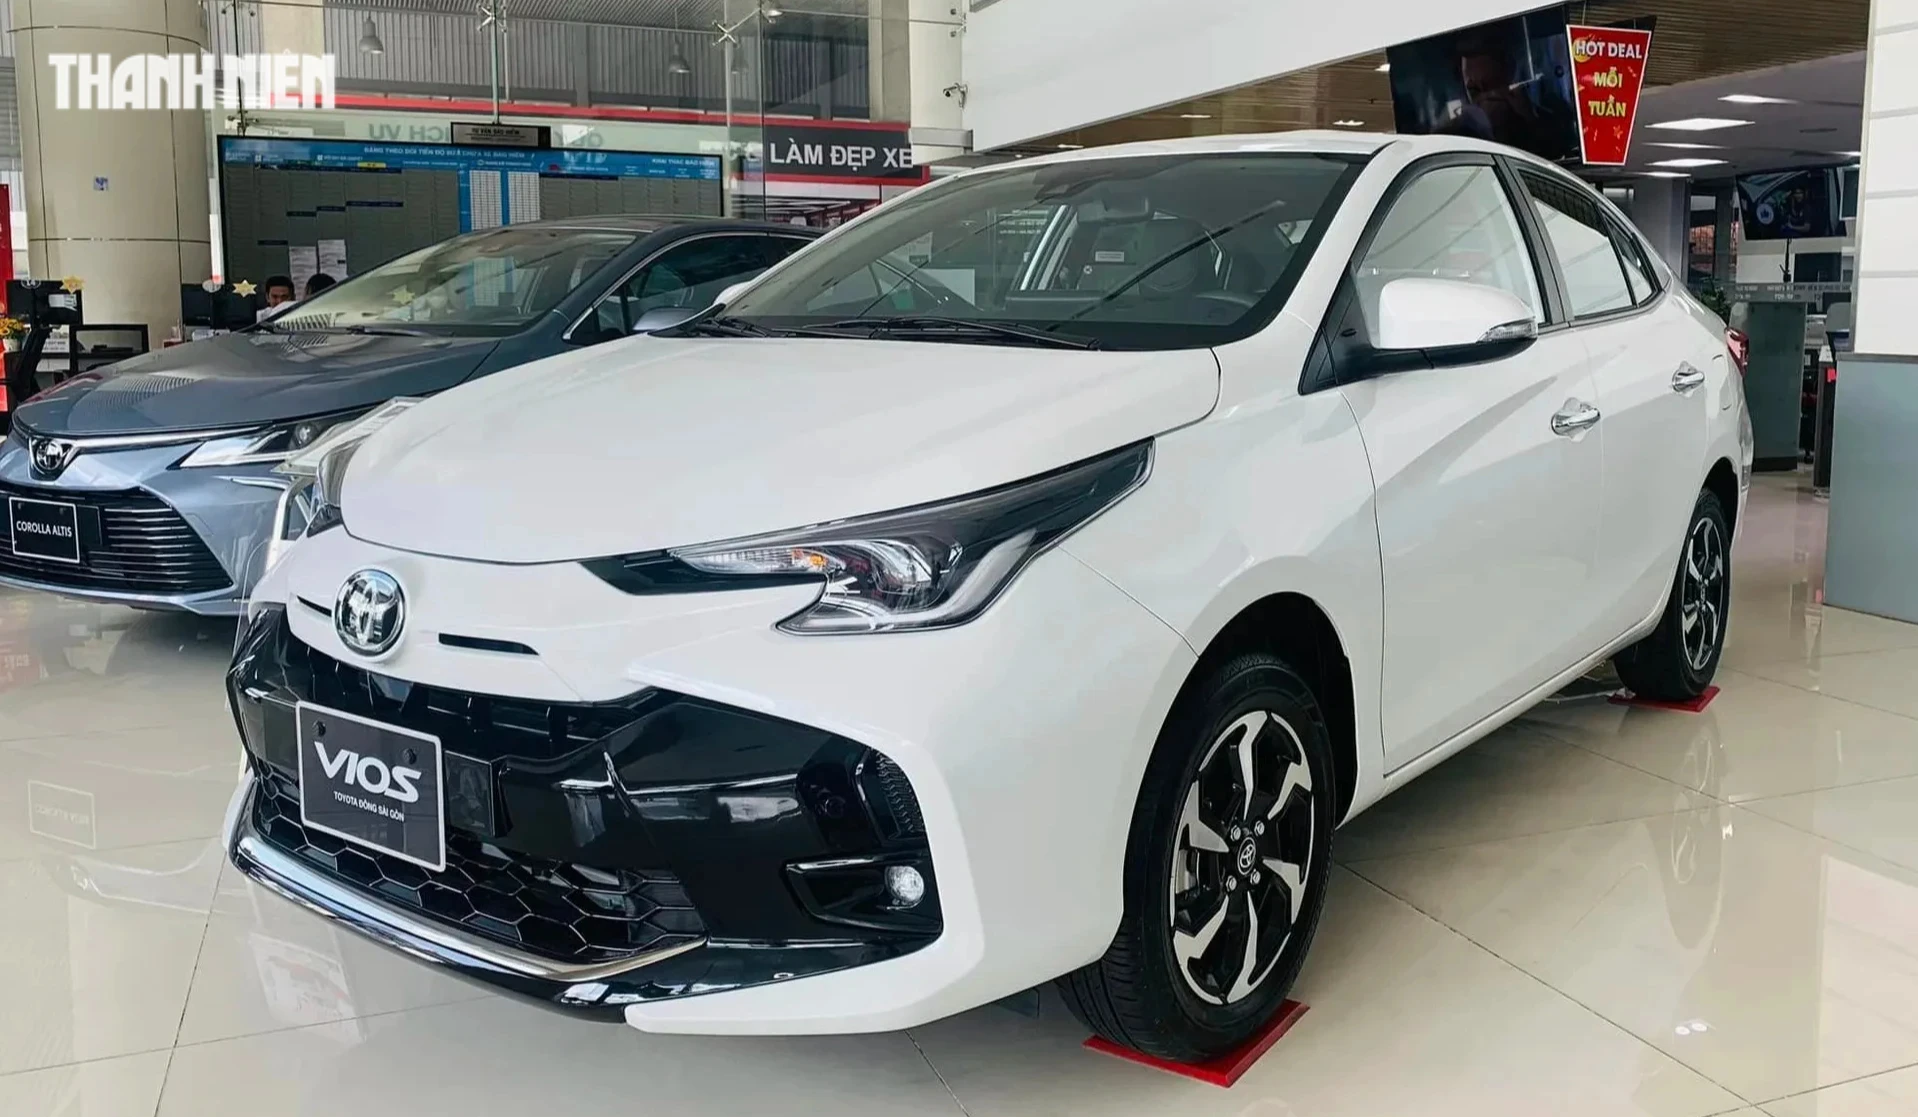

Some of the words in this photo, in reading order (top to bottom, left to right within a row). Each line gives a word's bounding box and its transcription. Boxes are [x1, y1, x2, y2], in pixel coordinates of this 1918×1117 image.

[1576, 41, 1606, 57] HOT
[1608, 43, 1642, 58] DEAL
[770, 137, 823, 165] LÀM
[830, 145, 876, 172] ĐẸP
[882, 148, 913, 168] XE
[16, 520, 51, 535] COROLLA
[52, 524, 72, 538] ALTIS
[314, 741, 422, 803] VIOS
[333, 791, 358, 807] TOYOTA
[359, 798, 377, 813] ĐÔNG
[378, 803, 389, 817] SÀI
